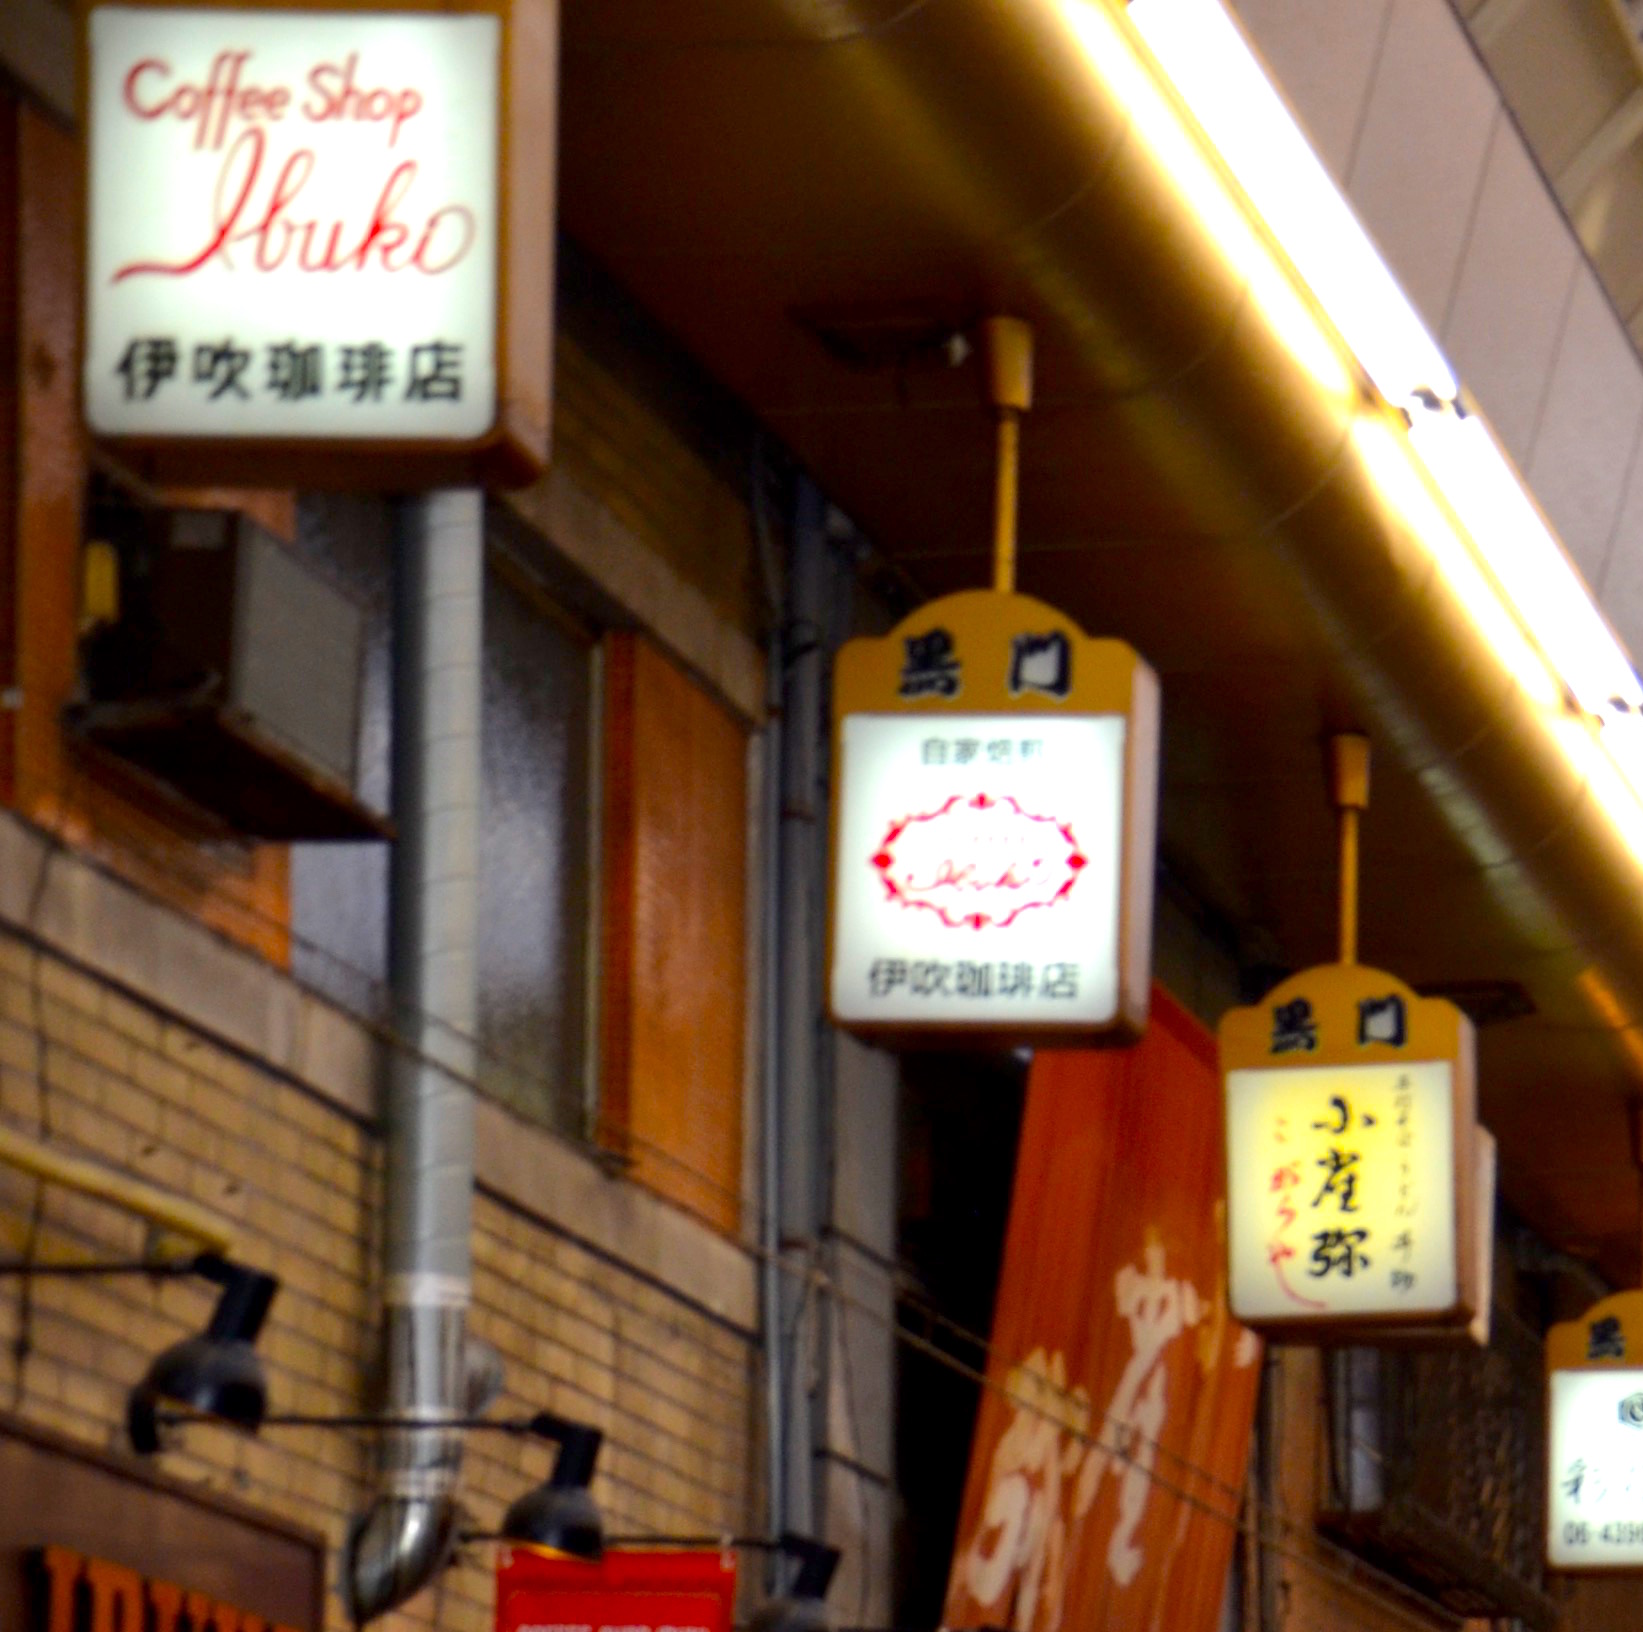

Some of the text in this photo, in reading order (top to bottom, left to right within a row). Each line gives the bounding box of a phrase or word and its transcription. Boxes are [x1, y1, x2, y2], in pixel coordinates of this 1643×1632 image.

[123, 53, 423, 150] Coffee Shop
[111, 129, 475, 285] Ibuki
[116, 338, 464, 402] 伊吹珈琲店
[868, 957, 1081, 998] 伊吹珈琲店
